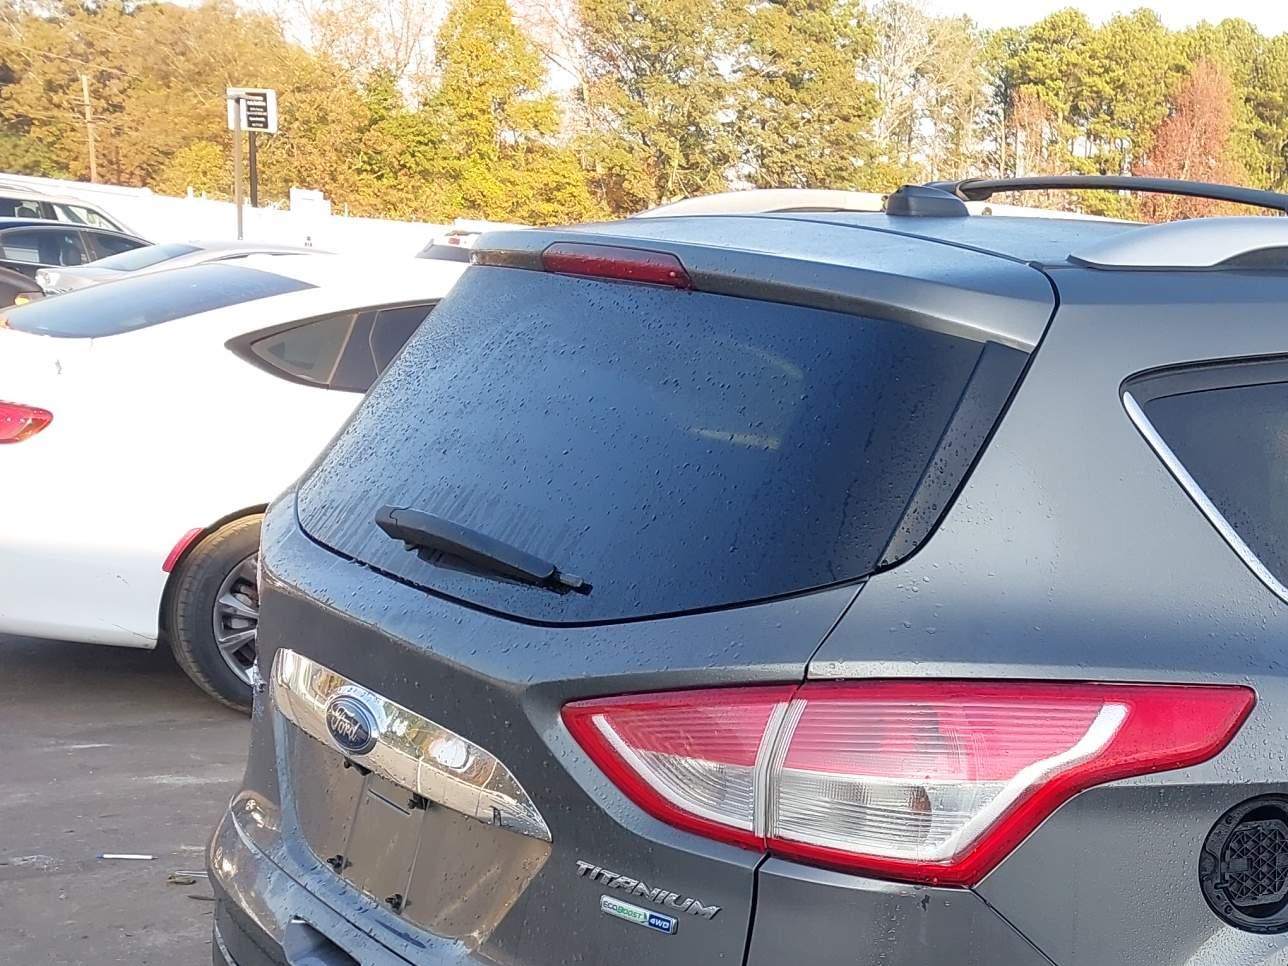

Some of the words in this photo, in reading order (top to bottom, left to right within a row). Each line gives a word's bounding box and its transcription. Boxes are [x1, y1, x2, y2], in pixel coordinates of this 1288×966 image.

[330, 706, 360, 741] Ford
[576, 860, 722, 919] TITANIUM
[649, 917, 671, 930] 4WD
